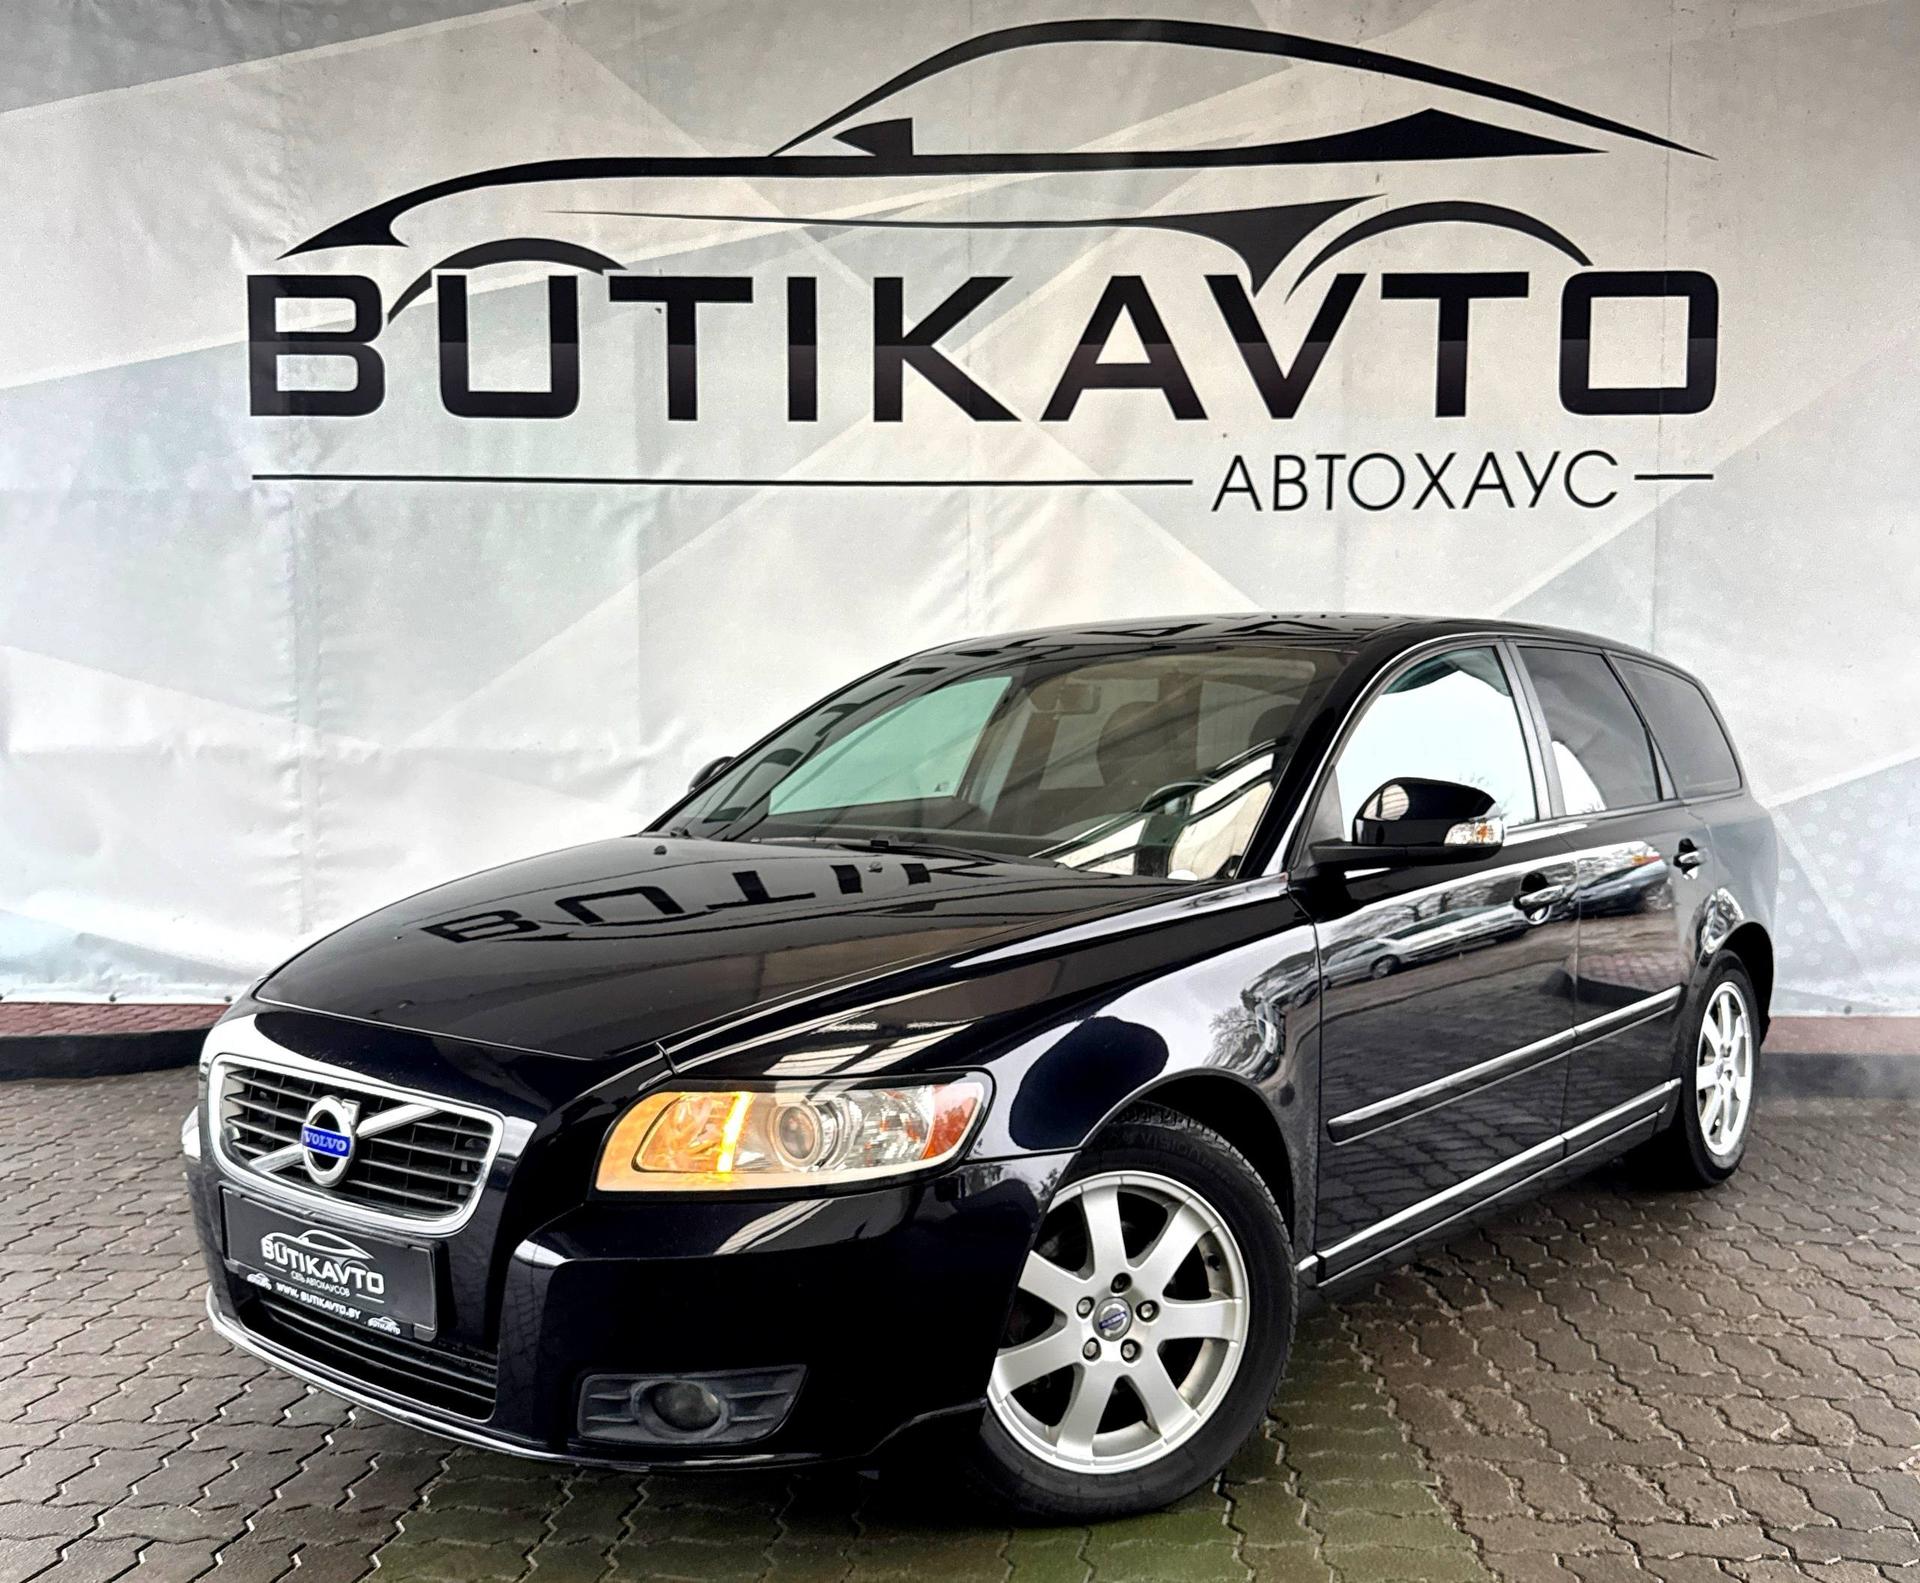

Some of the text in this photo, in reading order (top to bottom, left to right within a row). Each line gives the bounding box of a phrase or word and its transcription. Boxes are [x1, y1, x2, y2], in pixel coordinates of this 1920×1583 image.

[247, 270, 1719, 423] BUTIKAVTO
[1211, 449, 1619, 512] АВТОХАУС
[303, 1130, 348, 1151] VOLVO
[261, 1237, 385, 1295] BUTIKAVTO
